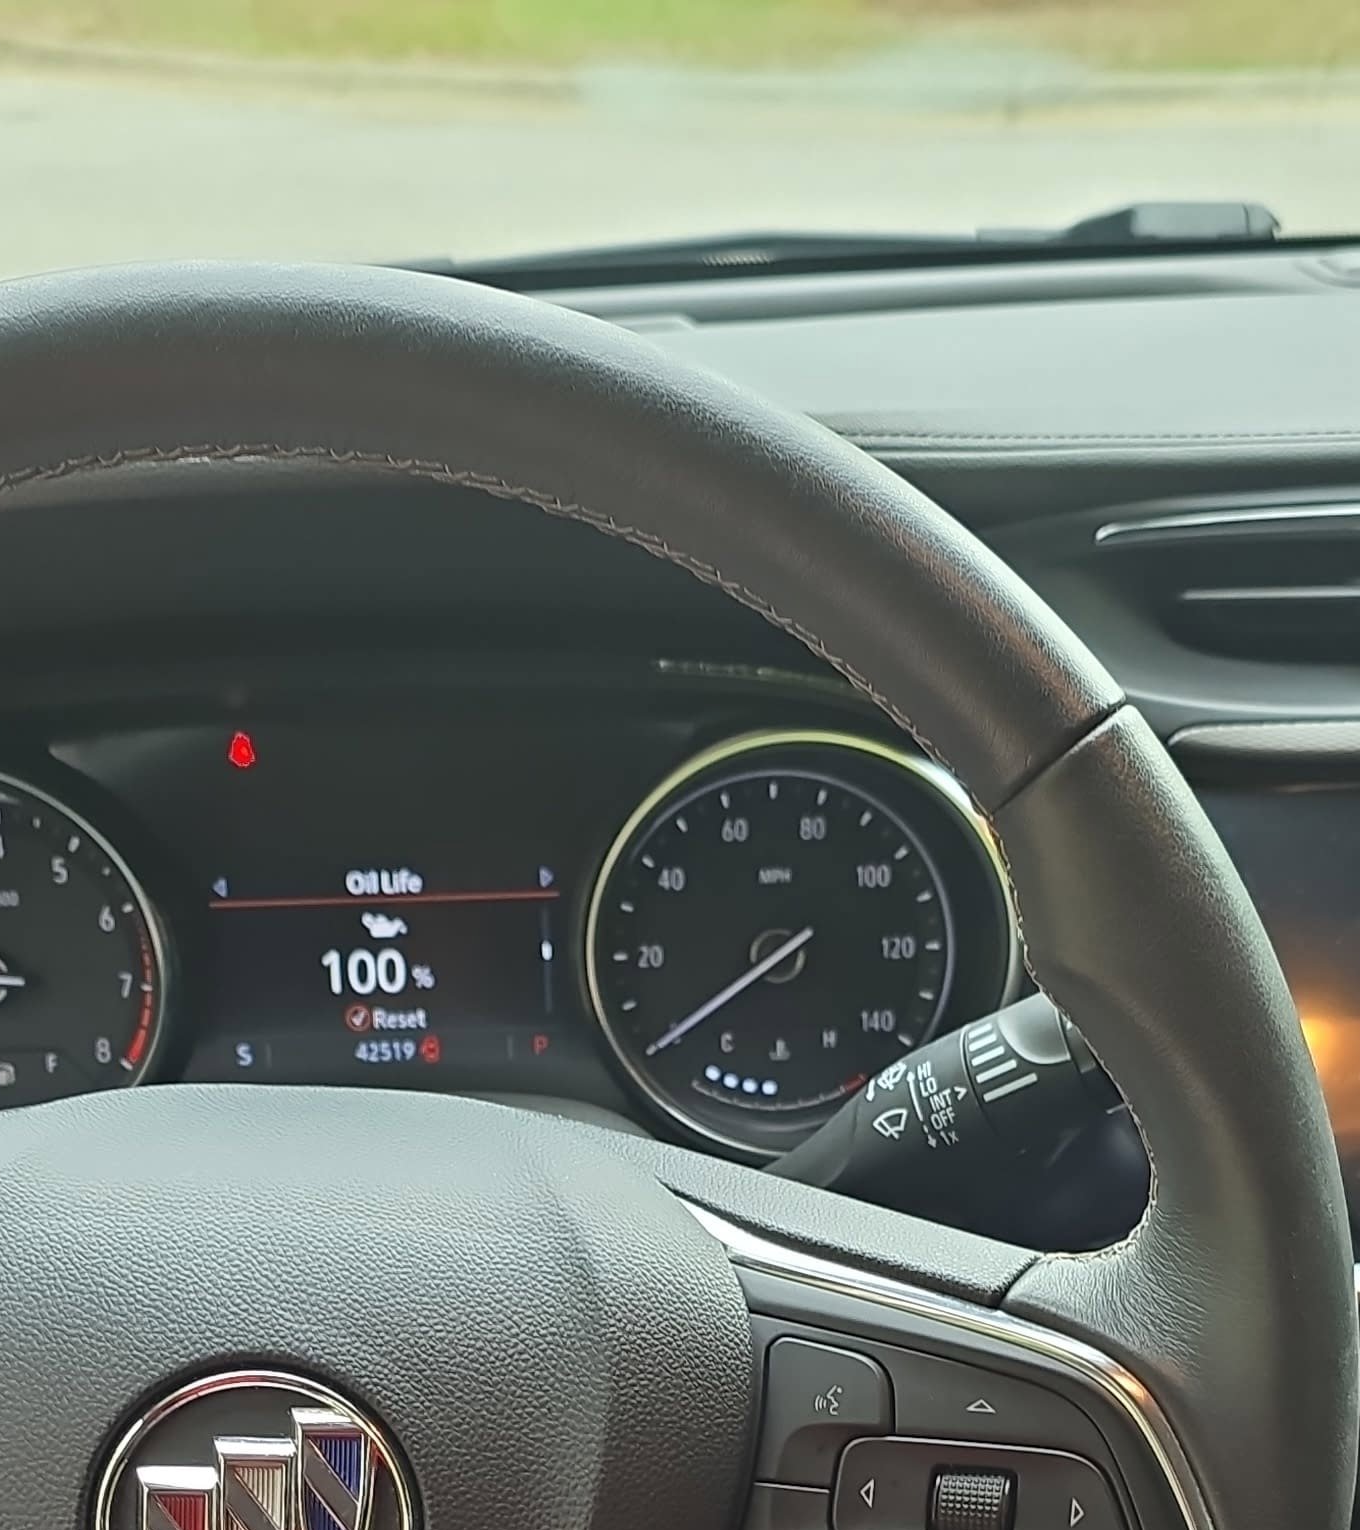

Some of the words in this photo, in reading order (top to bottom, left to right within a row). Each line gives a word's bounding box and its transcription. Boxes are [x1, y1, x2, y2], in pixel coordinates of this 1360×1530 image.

[722, 819, 748, 842] 60
[800, 818, 826, 841] 80
[52, 857, 68, 884] 5
[345, 871, 378, 896] Oil
[381, 868, 424, 894] Life
[659, 868, 684, 890] 40
[759, 868, 791, 884] MPH
[856, 865, 891, 888] 100
[98, 906, 115, 931] 6
[638, 946, 663, 967] 20
[882, 937, 915, 959] 120
[321, 948, 407, 995] 100
[412, 966, 435, 988] %
[119, 973, 132, 998] 7
[373, 1008, 427, 1030] Reset
[861, 1009, 893, 1032] 140
[95, 1038, 111, 1063] 8
[236, 1044, 253, 1067] S
[355, 1039, 416, 1062] 42519
[533, 1034, 549, 1056] P
[46, 1055, 57, 1074] F
[917, 1061, 931, 1080] HI
[920, 1077, 937, 1097] LO
[929, 1088, 952, 1112] INT
[931, 1107, 955, 1130] OFF
